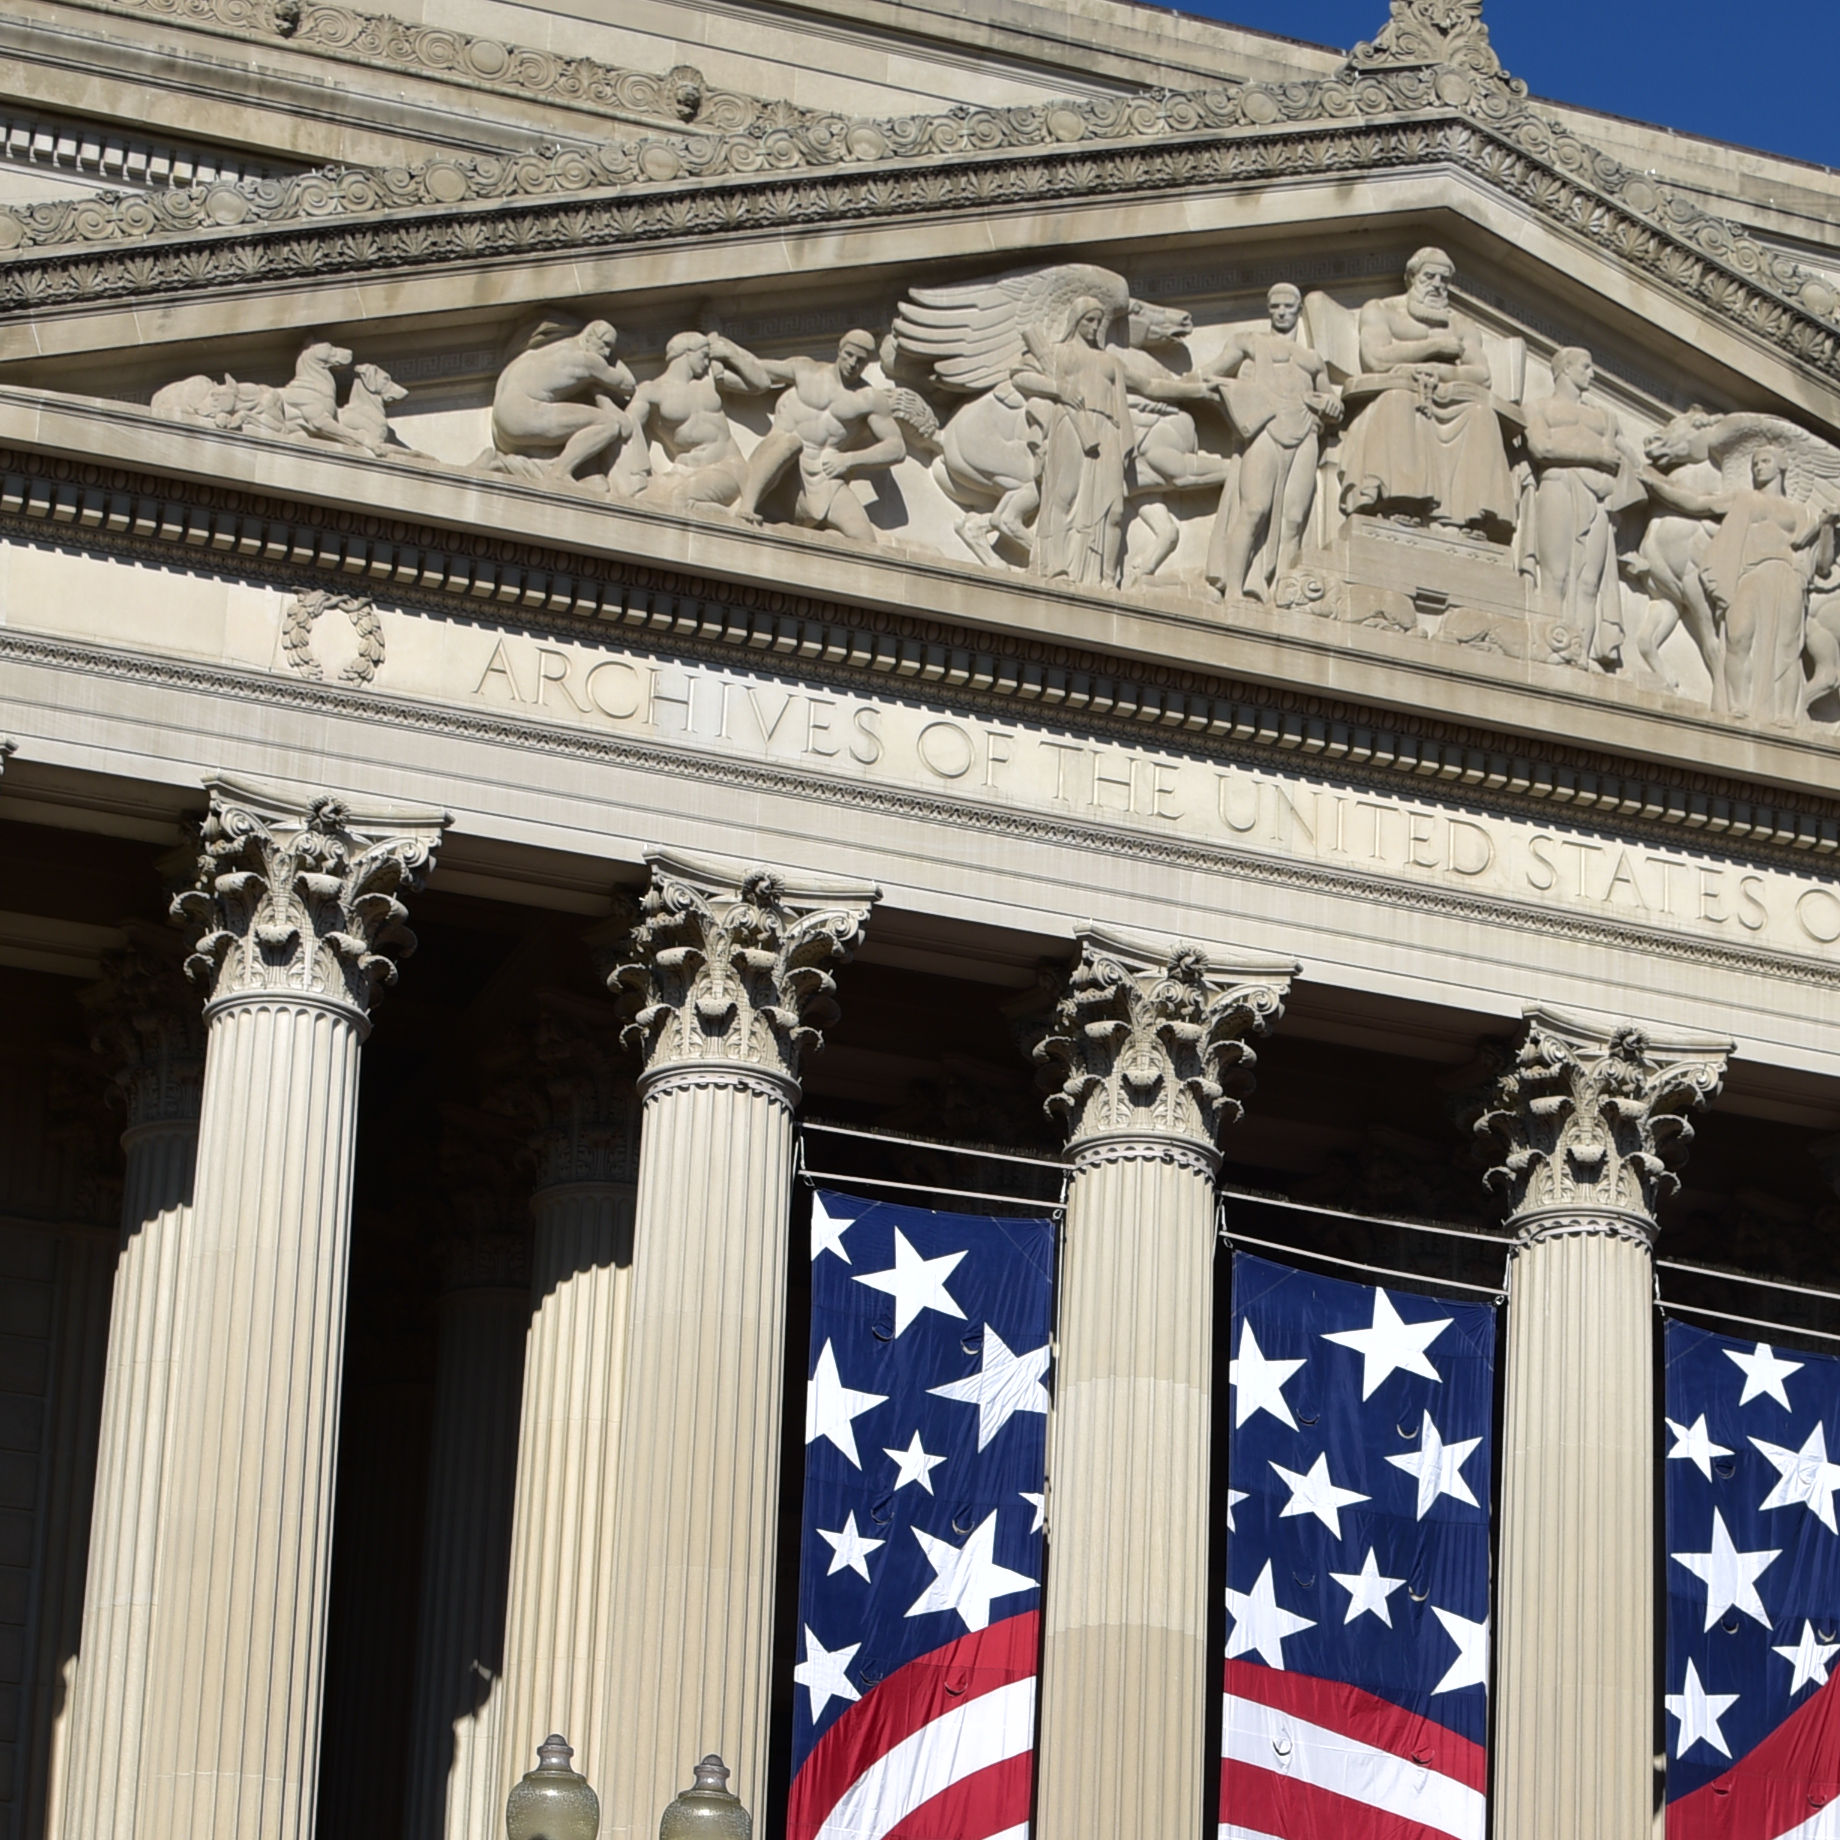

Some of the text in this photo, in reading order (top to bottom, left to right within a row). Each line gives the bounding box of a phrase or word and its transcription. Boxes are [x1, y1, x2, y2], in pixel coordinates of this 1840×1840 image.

[475, 637, 884, 765] ARCHIVES
[917, 721, 1015, 789] OF
[1041, 743, 1185, 822] THE
[1217, 774, 1494, 877] UNITED
[1525, 833, 1767, 932] STATES
